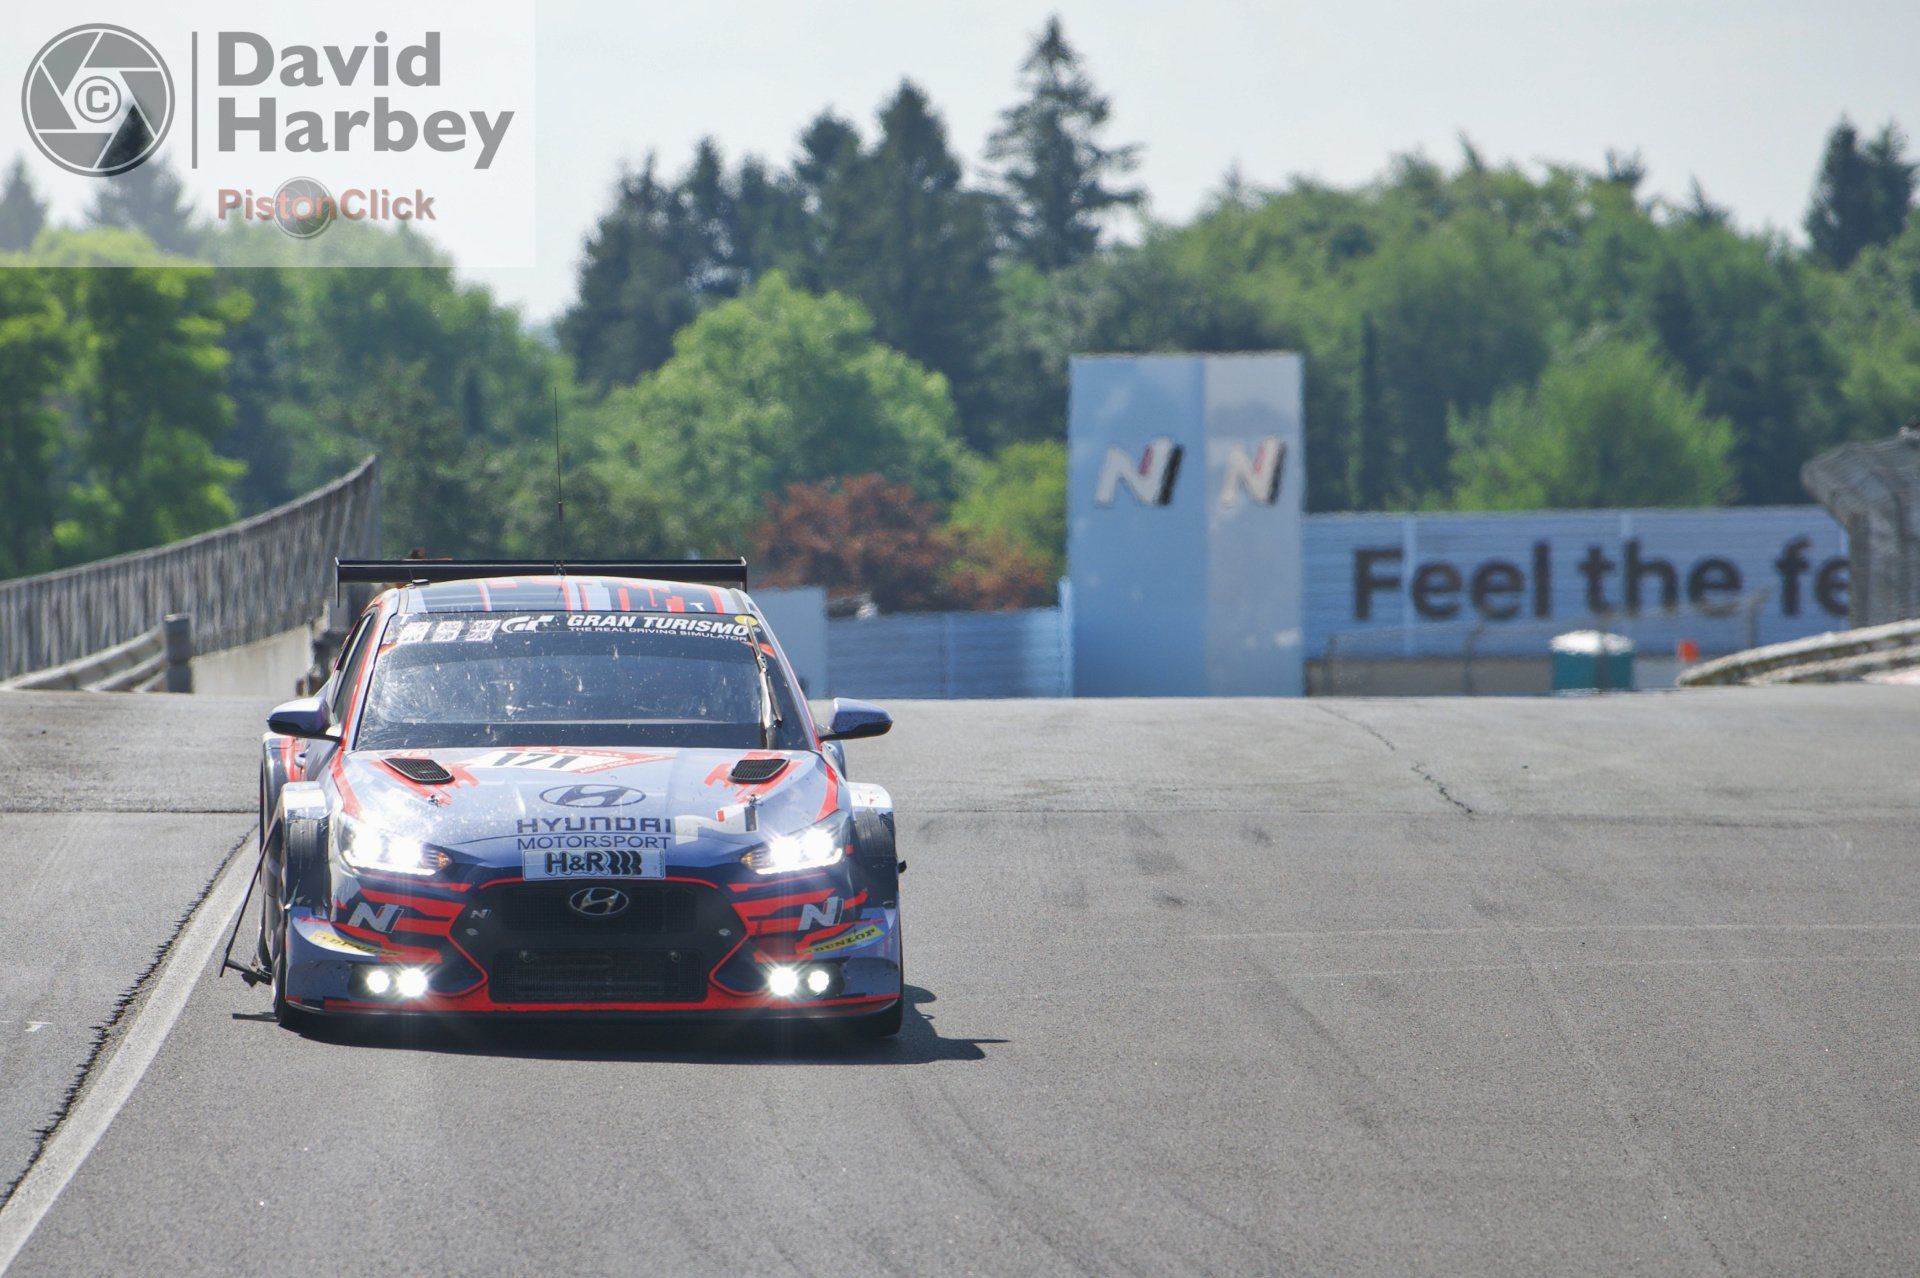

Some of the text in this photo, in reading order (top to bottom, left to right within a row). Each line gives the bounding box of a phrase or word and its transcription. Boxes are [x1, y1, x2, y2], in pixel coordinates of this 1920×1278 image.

[1354, 540, 1550, 621] Feel
[1578, 538, 1742, 618] the
[567, 615, 636, 627] GRAN
[643, 617, 750, 636] TURISMO
[629, 627, 676, 635] DRIVING
[680, 631, 747, 641] SIMULATOR
[493, 752, 580, 769] 171
[516, 816, 672, 834] HYUNDAI
[517, 836, 671, 850] MOTORSPORT
[546, 851, 604, 873] H&R
